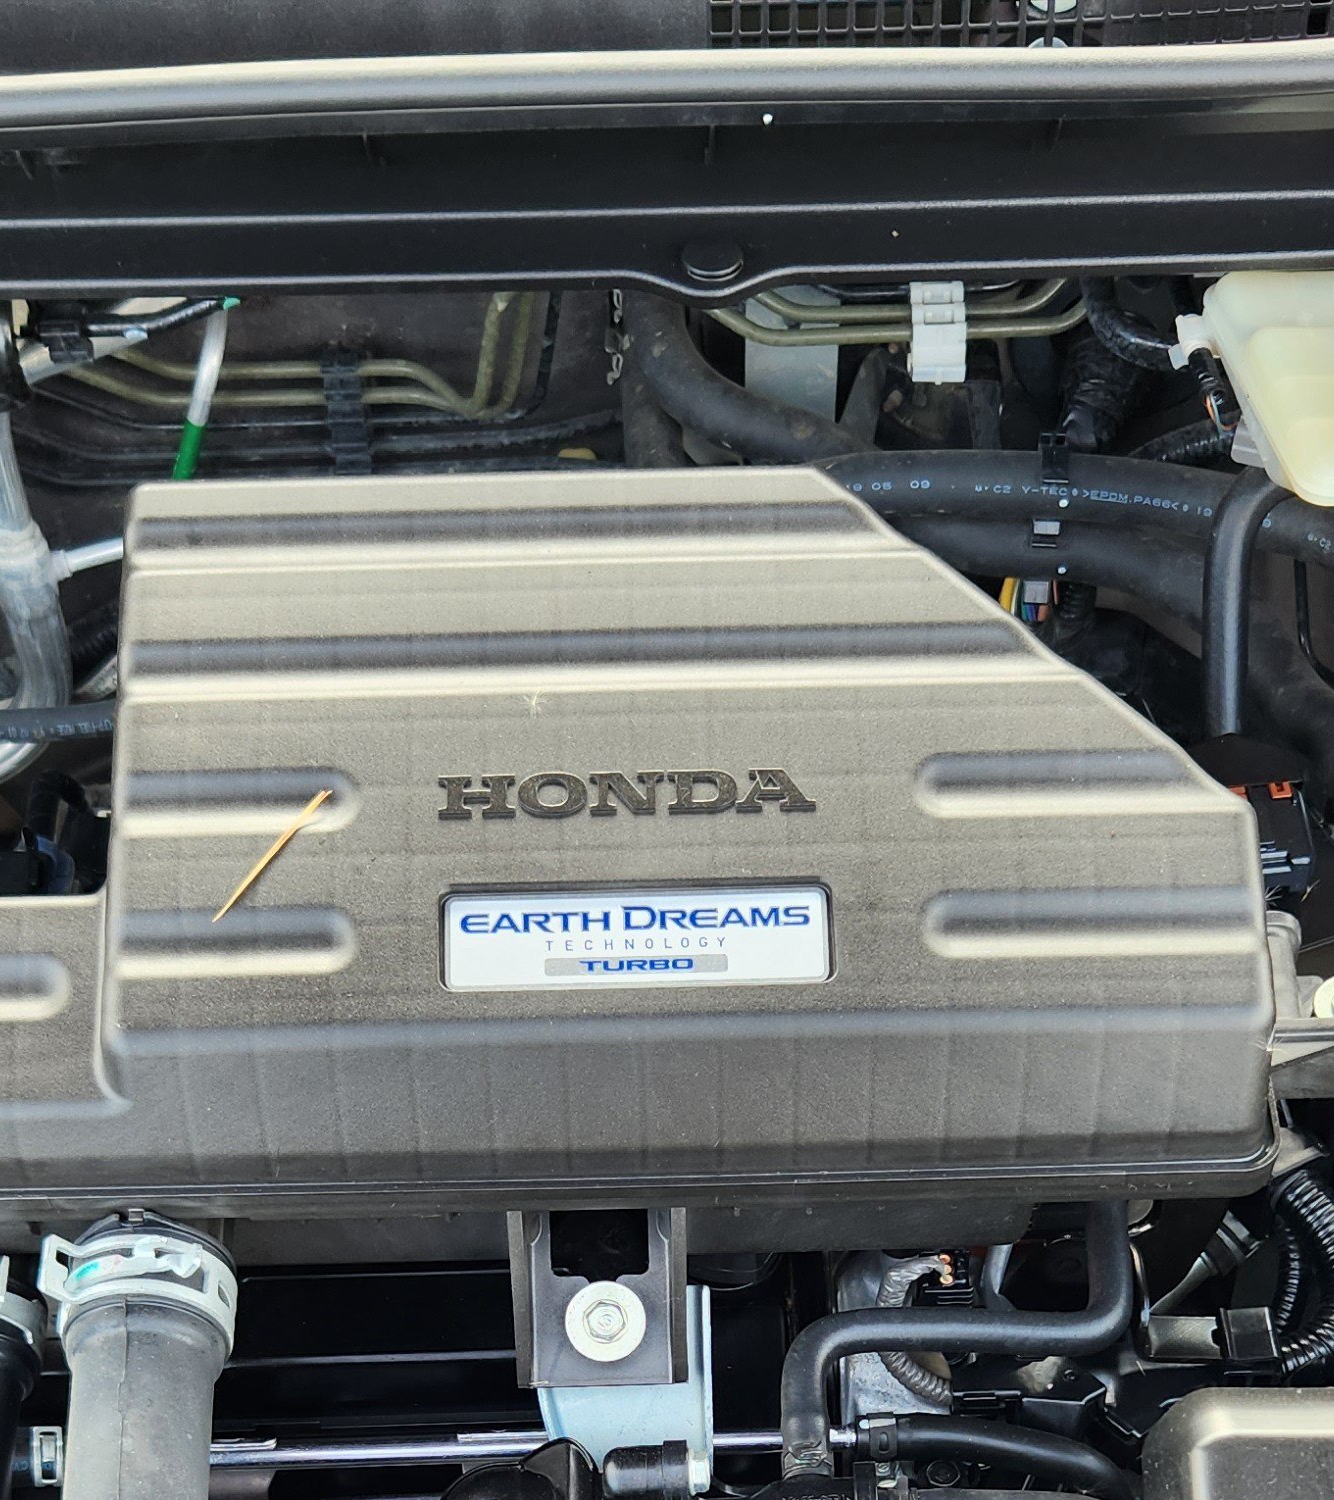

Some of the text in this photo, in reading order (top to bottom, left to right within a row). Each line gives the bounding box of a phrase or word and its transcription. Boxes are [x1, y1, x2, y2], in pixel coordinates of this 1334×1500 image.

[437, 767, 817, 821] HONDA
[459, 905, 811, 935] EARTH DREAMS
[544, 935, 727, 952] TECHNOLOGY
[579, 957, 695, 972] TURBO
